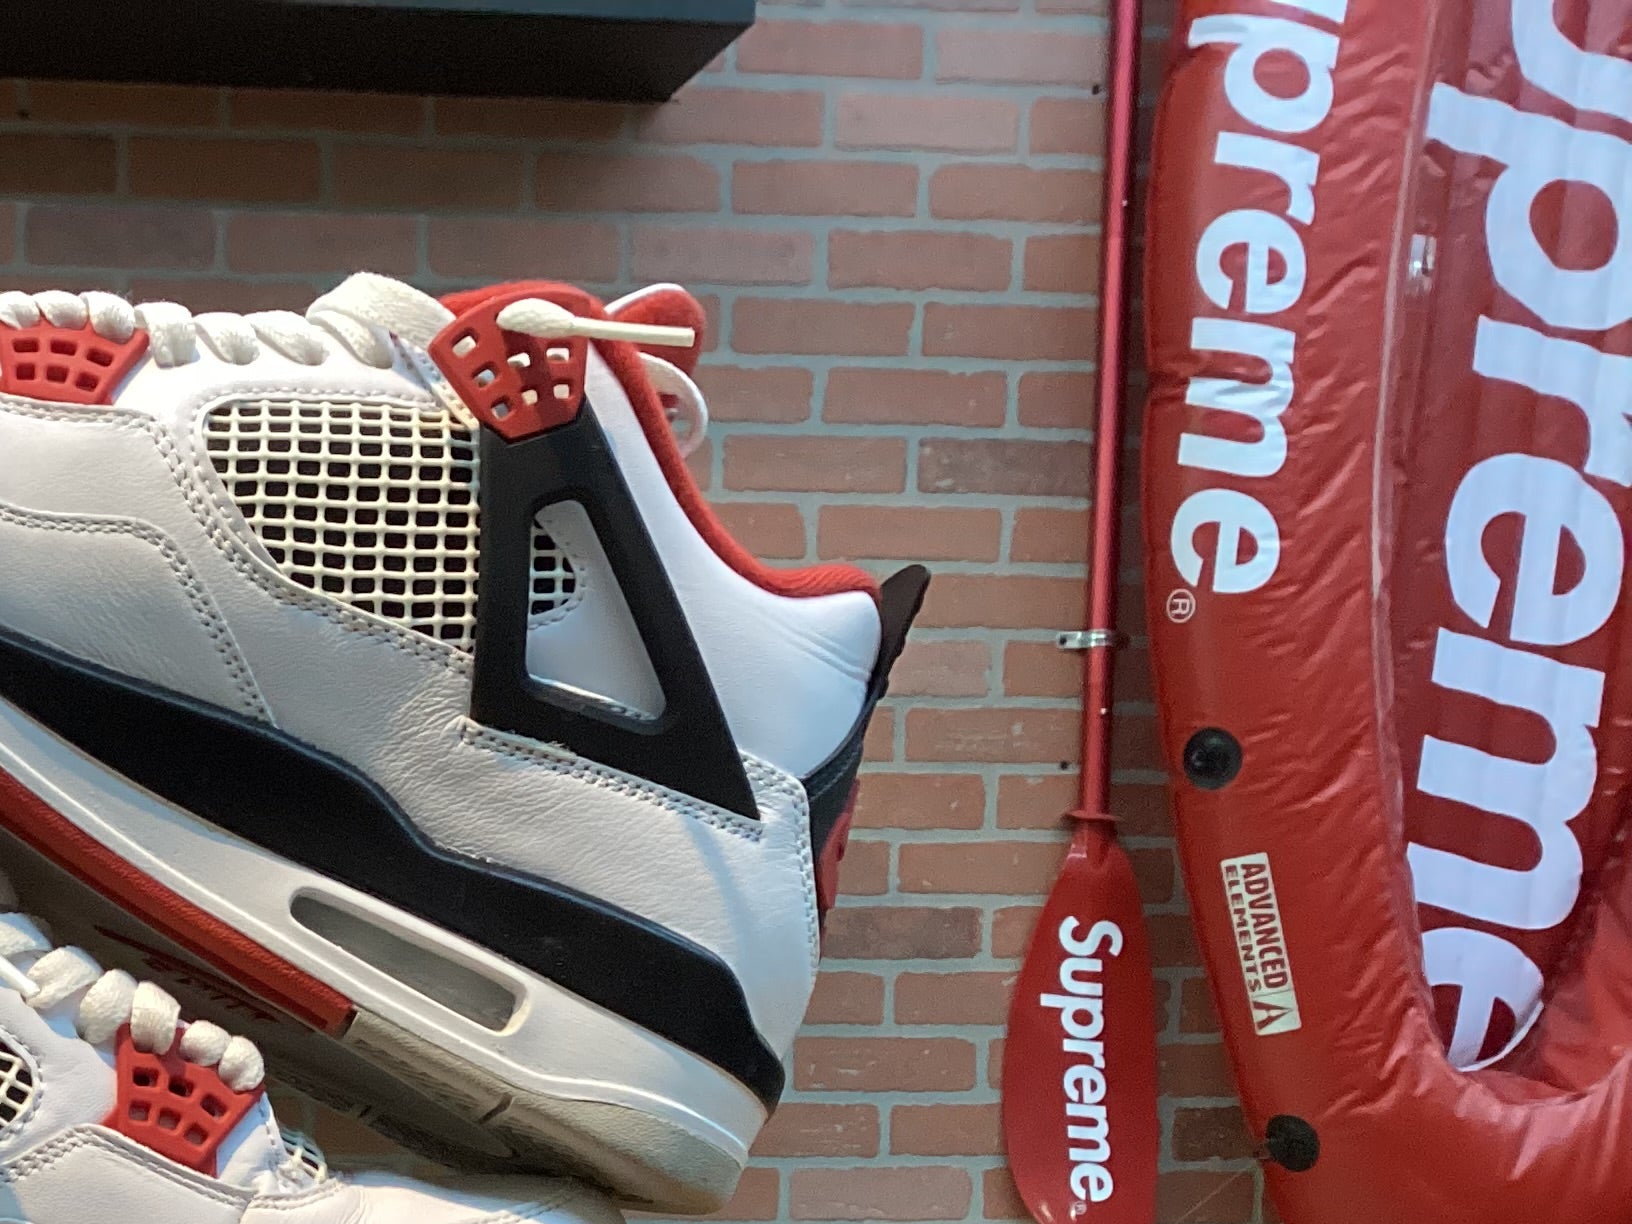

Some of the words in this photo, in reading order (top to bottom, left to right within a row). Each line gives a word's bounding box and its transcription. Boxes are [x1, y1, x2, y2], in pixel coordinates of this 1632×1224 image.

[1170, 0, 1351, 594] preme
[1224, 864, 1262, 993] ELEMENTS
[1240, 862, 1289, 989] ADVANCED
[1039, 915, 1124, 1203] Supreme
